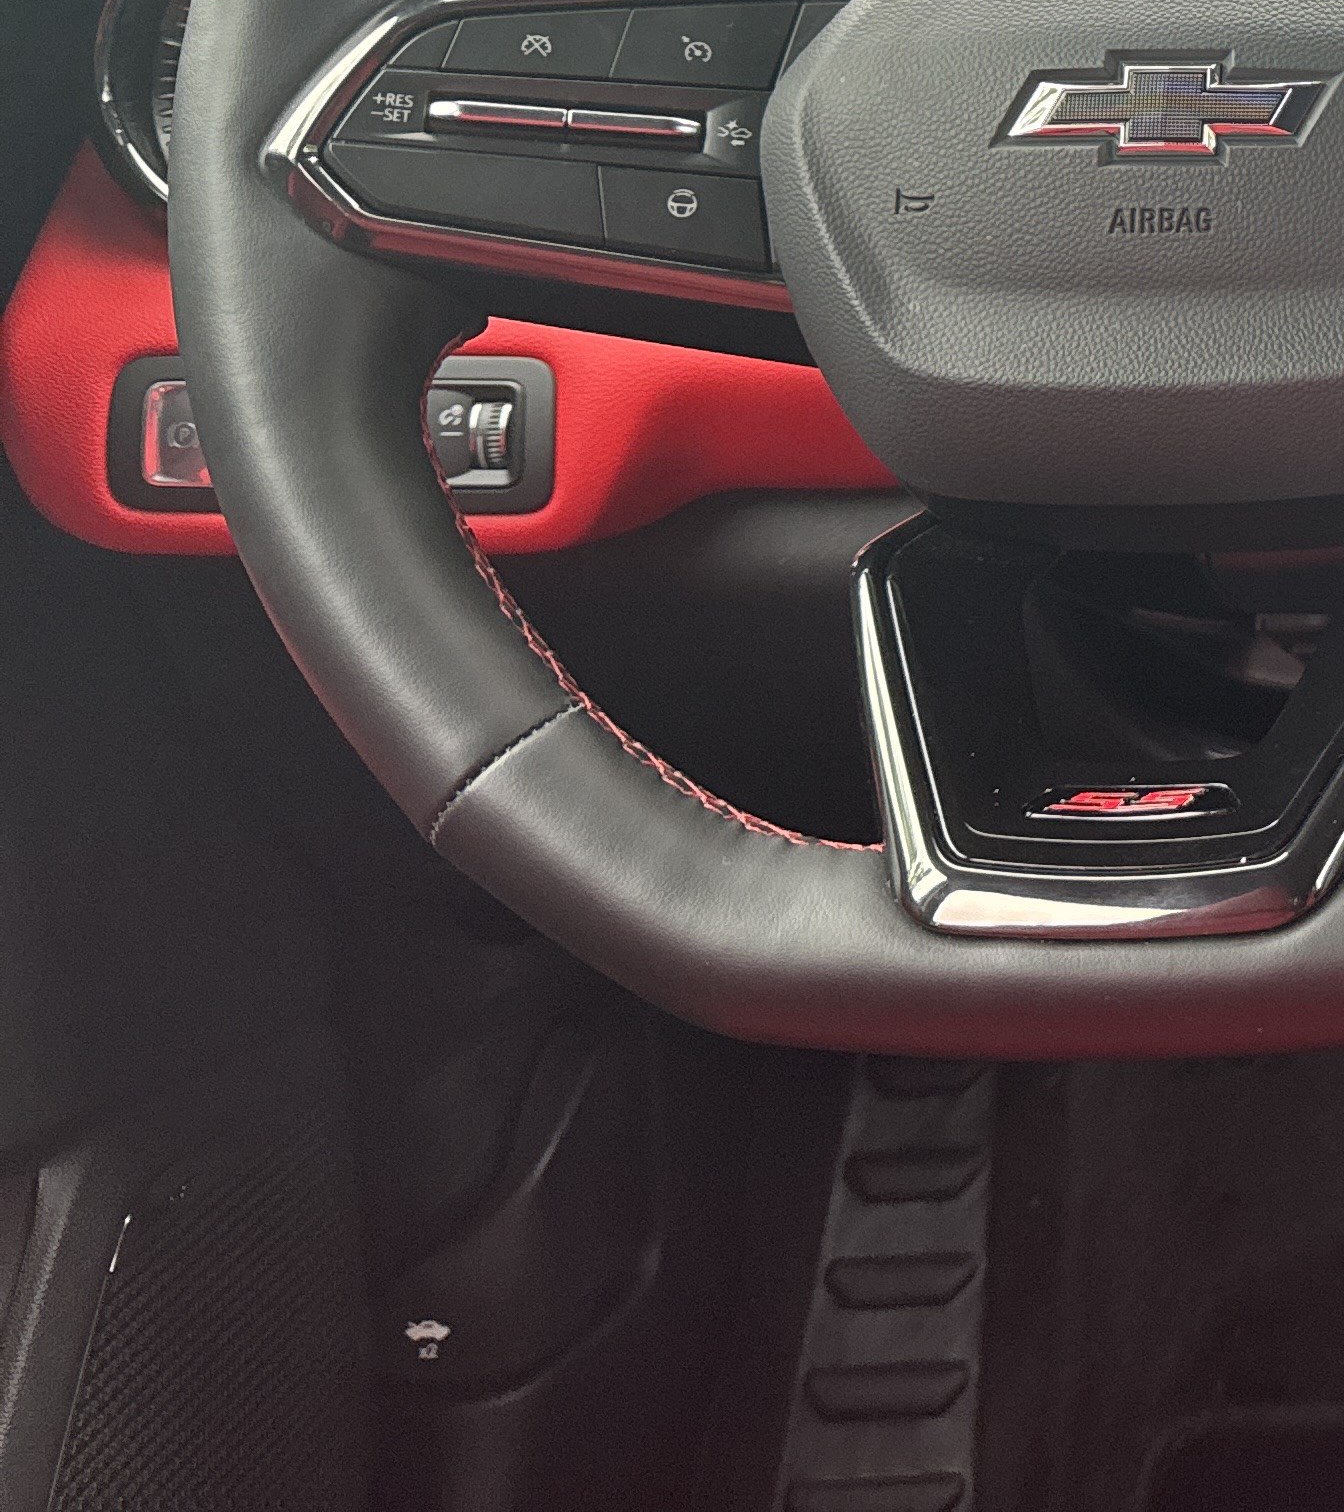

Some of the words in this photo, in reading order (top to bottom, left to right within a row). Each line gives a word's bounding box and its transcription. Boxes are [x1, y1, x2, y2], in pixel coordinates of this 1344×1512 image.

[372, 92, 414, 108] +RES
[1107, 207, 1213, 234] AIRBAG
[1043, 788, 1208, 813] SS
